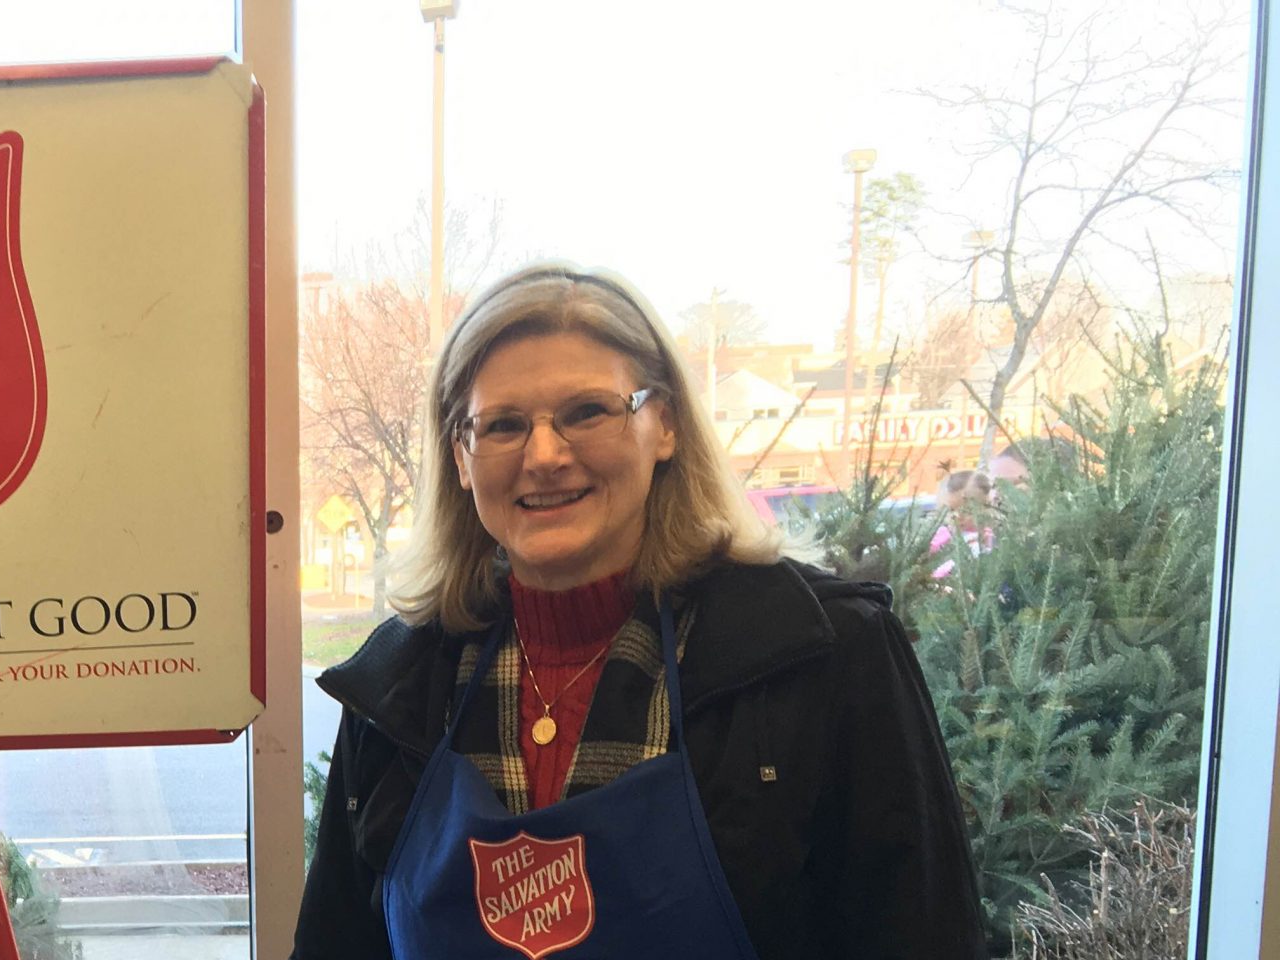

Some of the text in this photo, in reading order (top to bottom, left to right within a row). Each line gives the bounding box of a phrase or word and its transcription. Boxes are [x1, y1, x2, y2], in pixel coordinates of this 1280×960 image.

[28, 592, 197, 638] GOOD
[8, 663, 70, 682] YOUR
[76, 656, 201, 680] DONATION.
[485, 847, 577, 924] SALVATION
[491, 844, 535, 884] THE
[520, 884, 576, 943] ARMY
